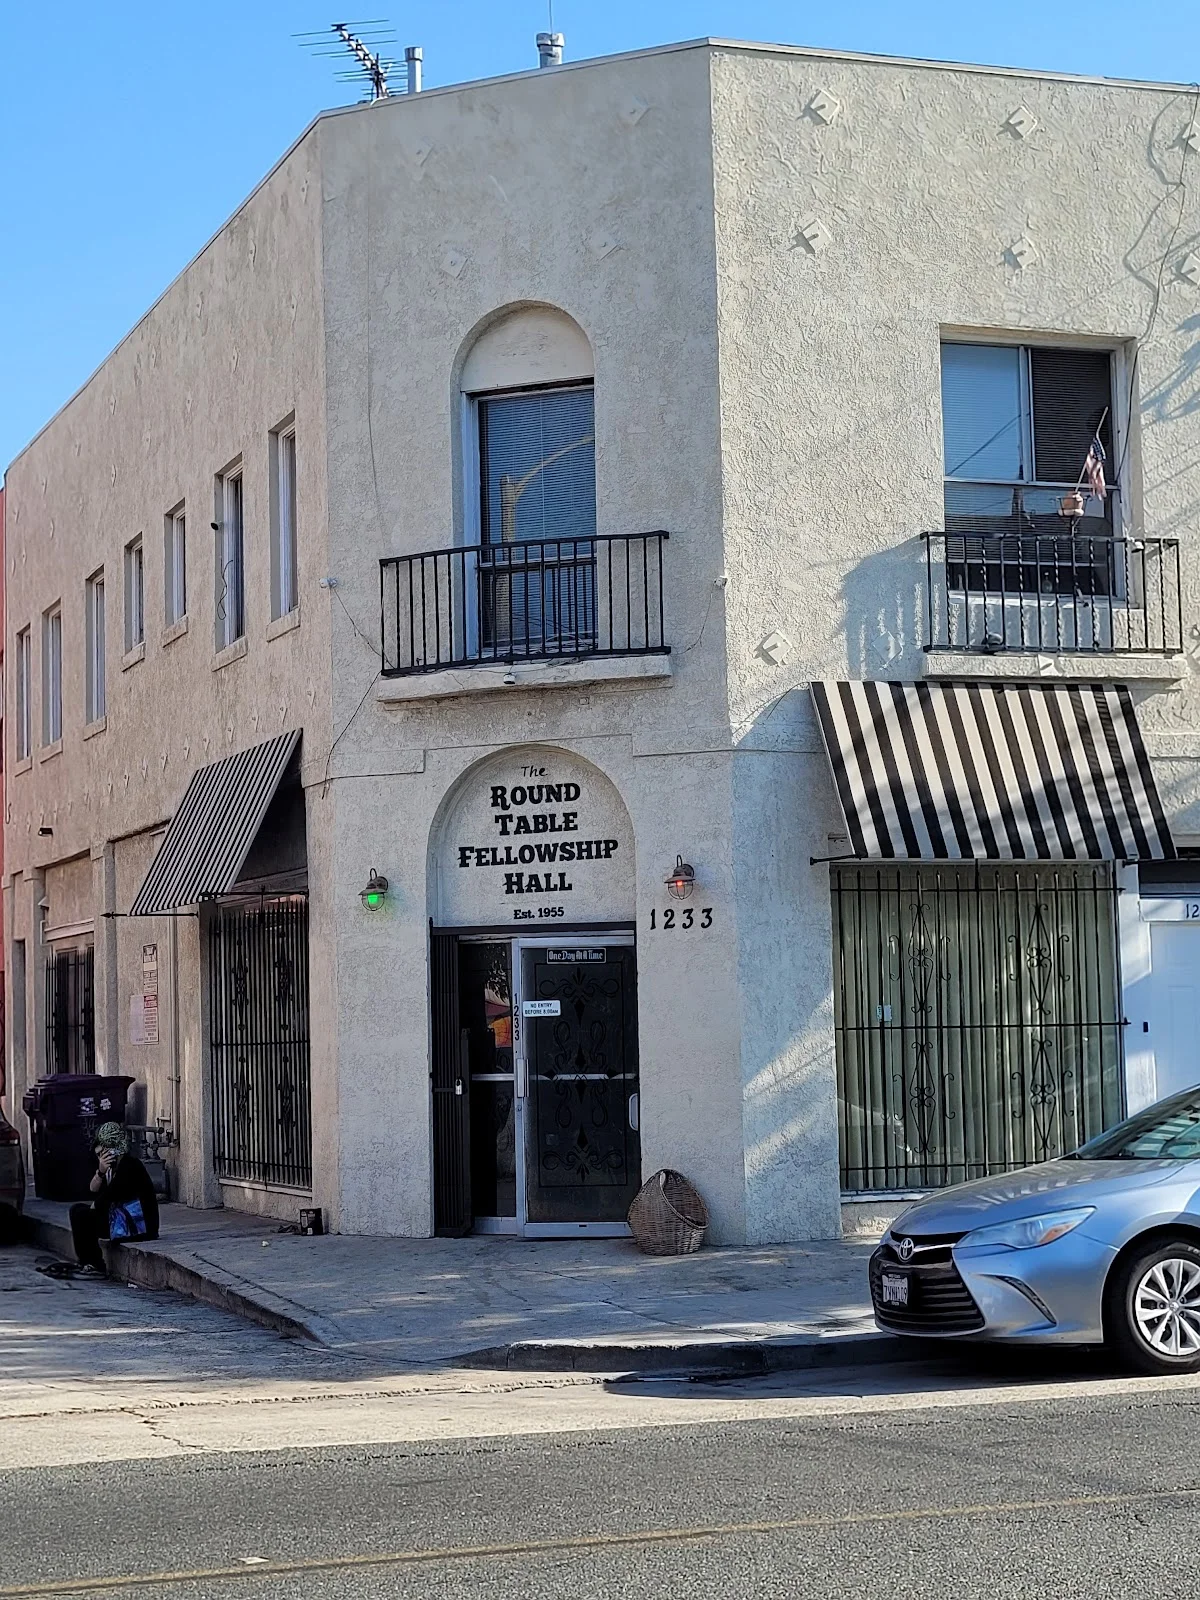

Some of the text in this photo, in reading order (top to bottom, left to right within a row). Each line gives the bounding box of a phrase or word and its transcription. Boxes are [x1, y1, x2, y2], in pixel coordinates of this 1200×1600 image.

[521, 765, 548, 778] The
[490, 783, 581, 810] ROUND
[495, 812, 578, 836] TABLE
[457, 839, 619, 868] FELLOWSHIP
[504, 872, 573, 894] HALL
[513, 906, 565, 920] Est. 1955
[650, 907, 714, 930] 1233
[1186, 903, 1199, 919] 12
[548, 950, 561, 960] One
[561, 950, 575, 962] Day
[588, 949, 603, 960] Time
